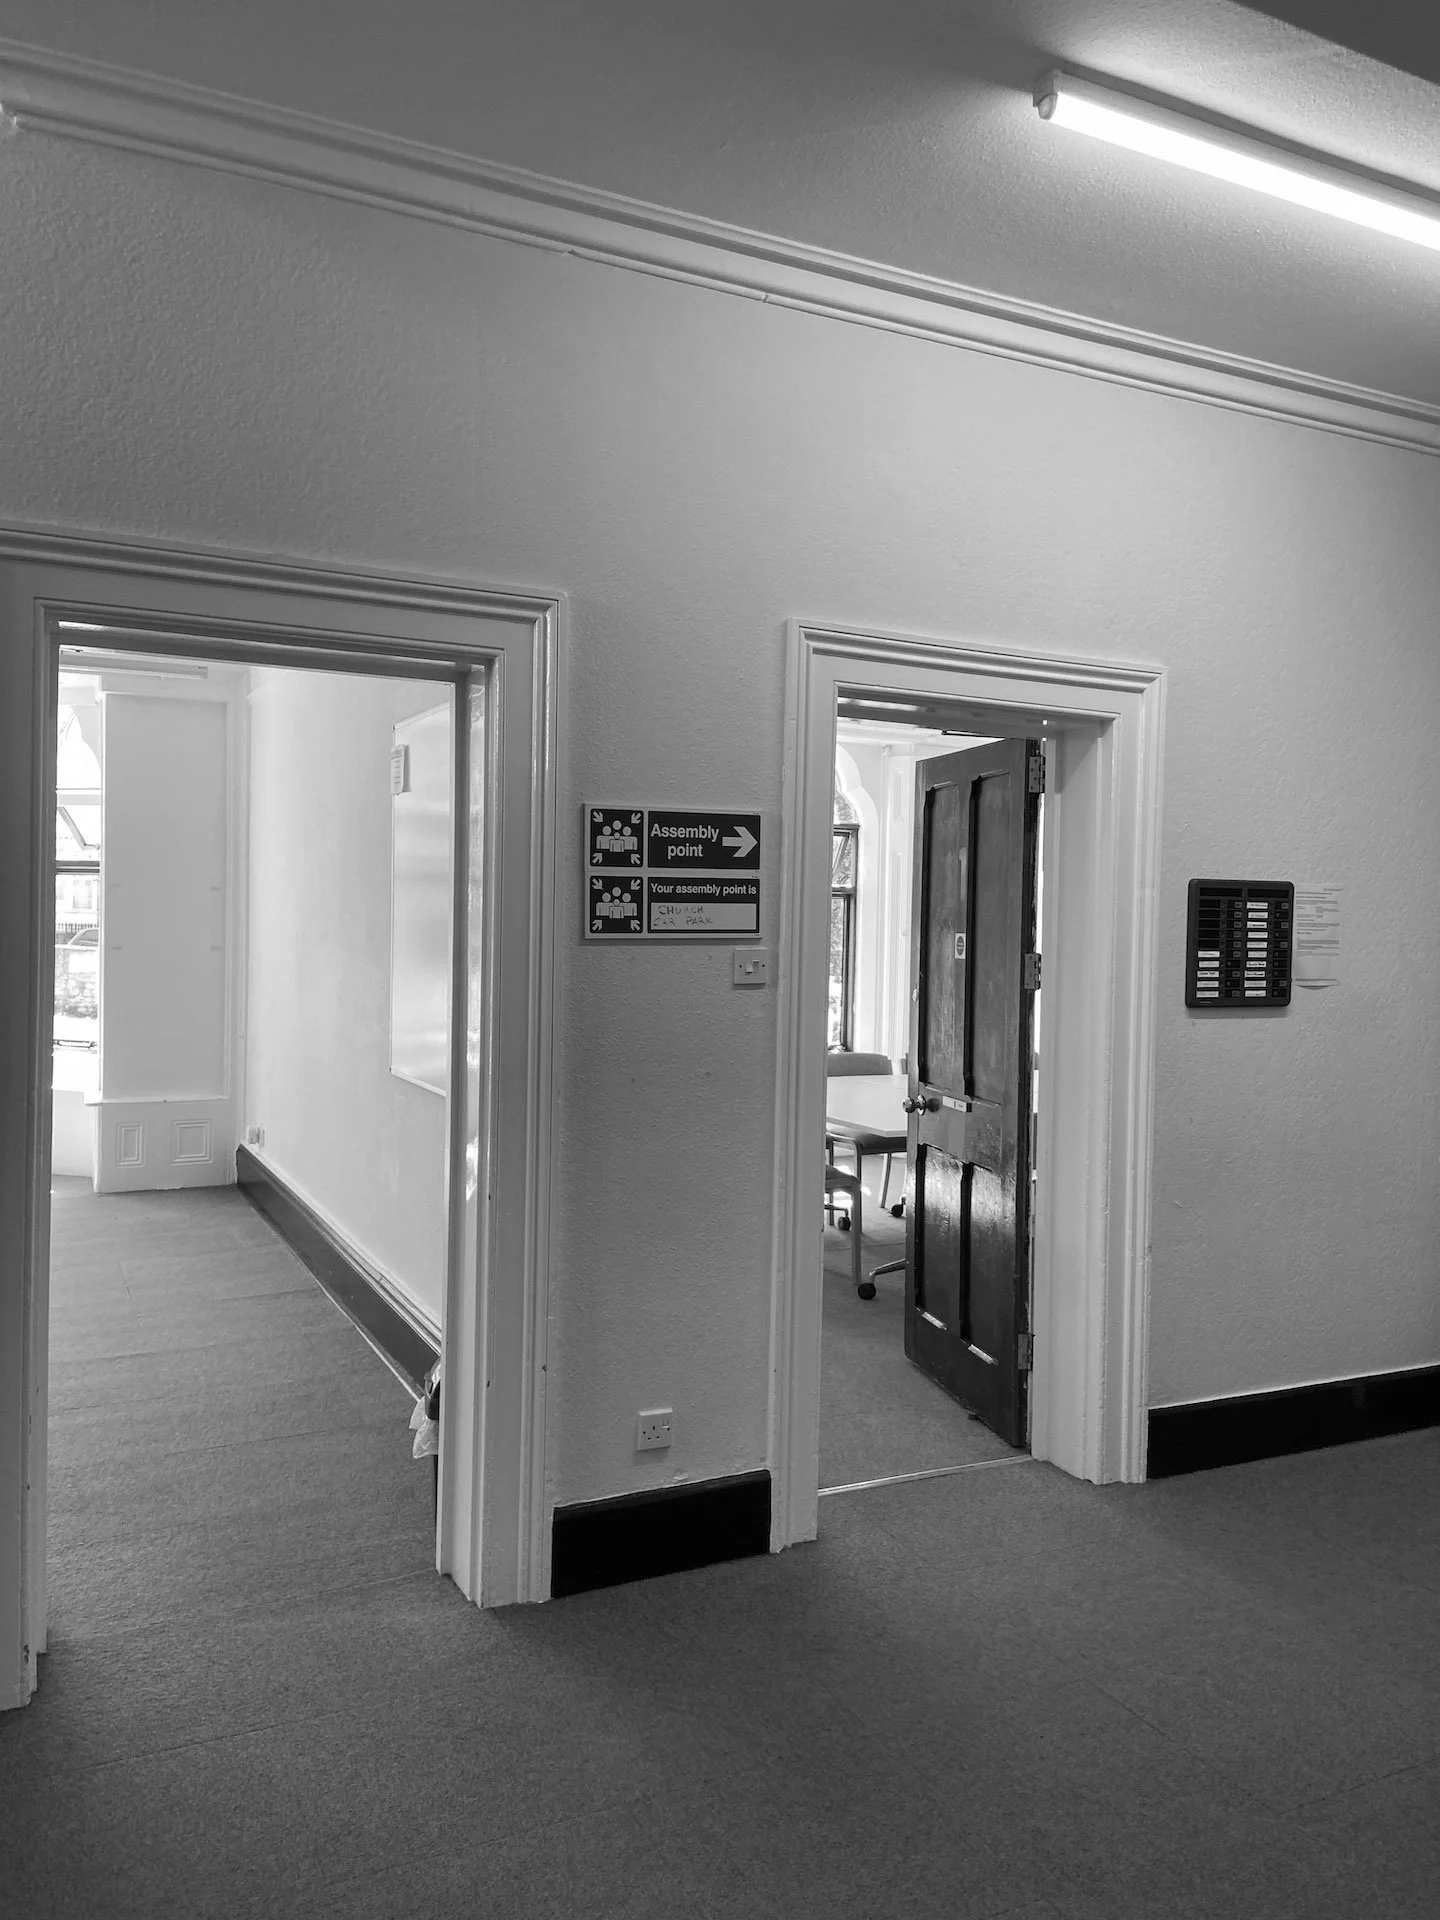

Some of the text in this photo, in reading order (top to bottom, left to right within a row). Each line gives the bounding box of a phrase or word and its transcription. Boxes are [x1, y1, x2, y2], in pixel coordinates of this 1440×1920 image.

[650, 823, 720, 843] Assembly
[667, 843, 703, 860] point
[650, 883, 757, 896] Your assembly point is
[685, 915, 713, 926] PARK
